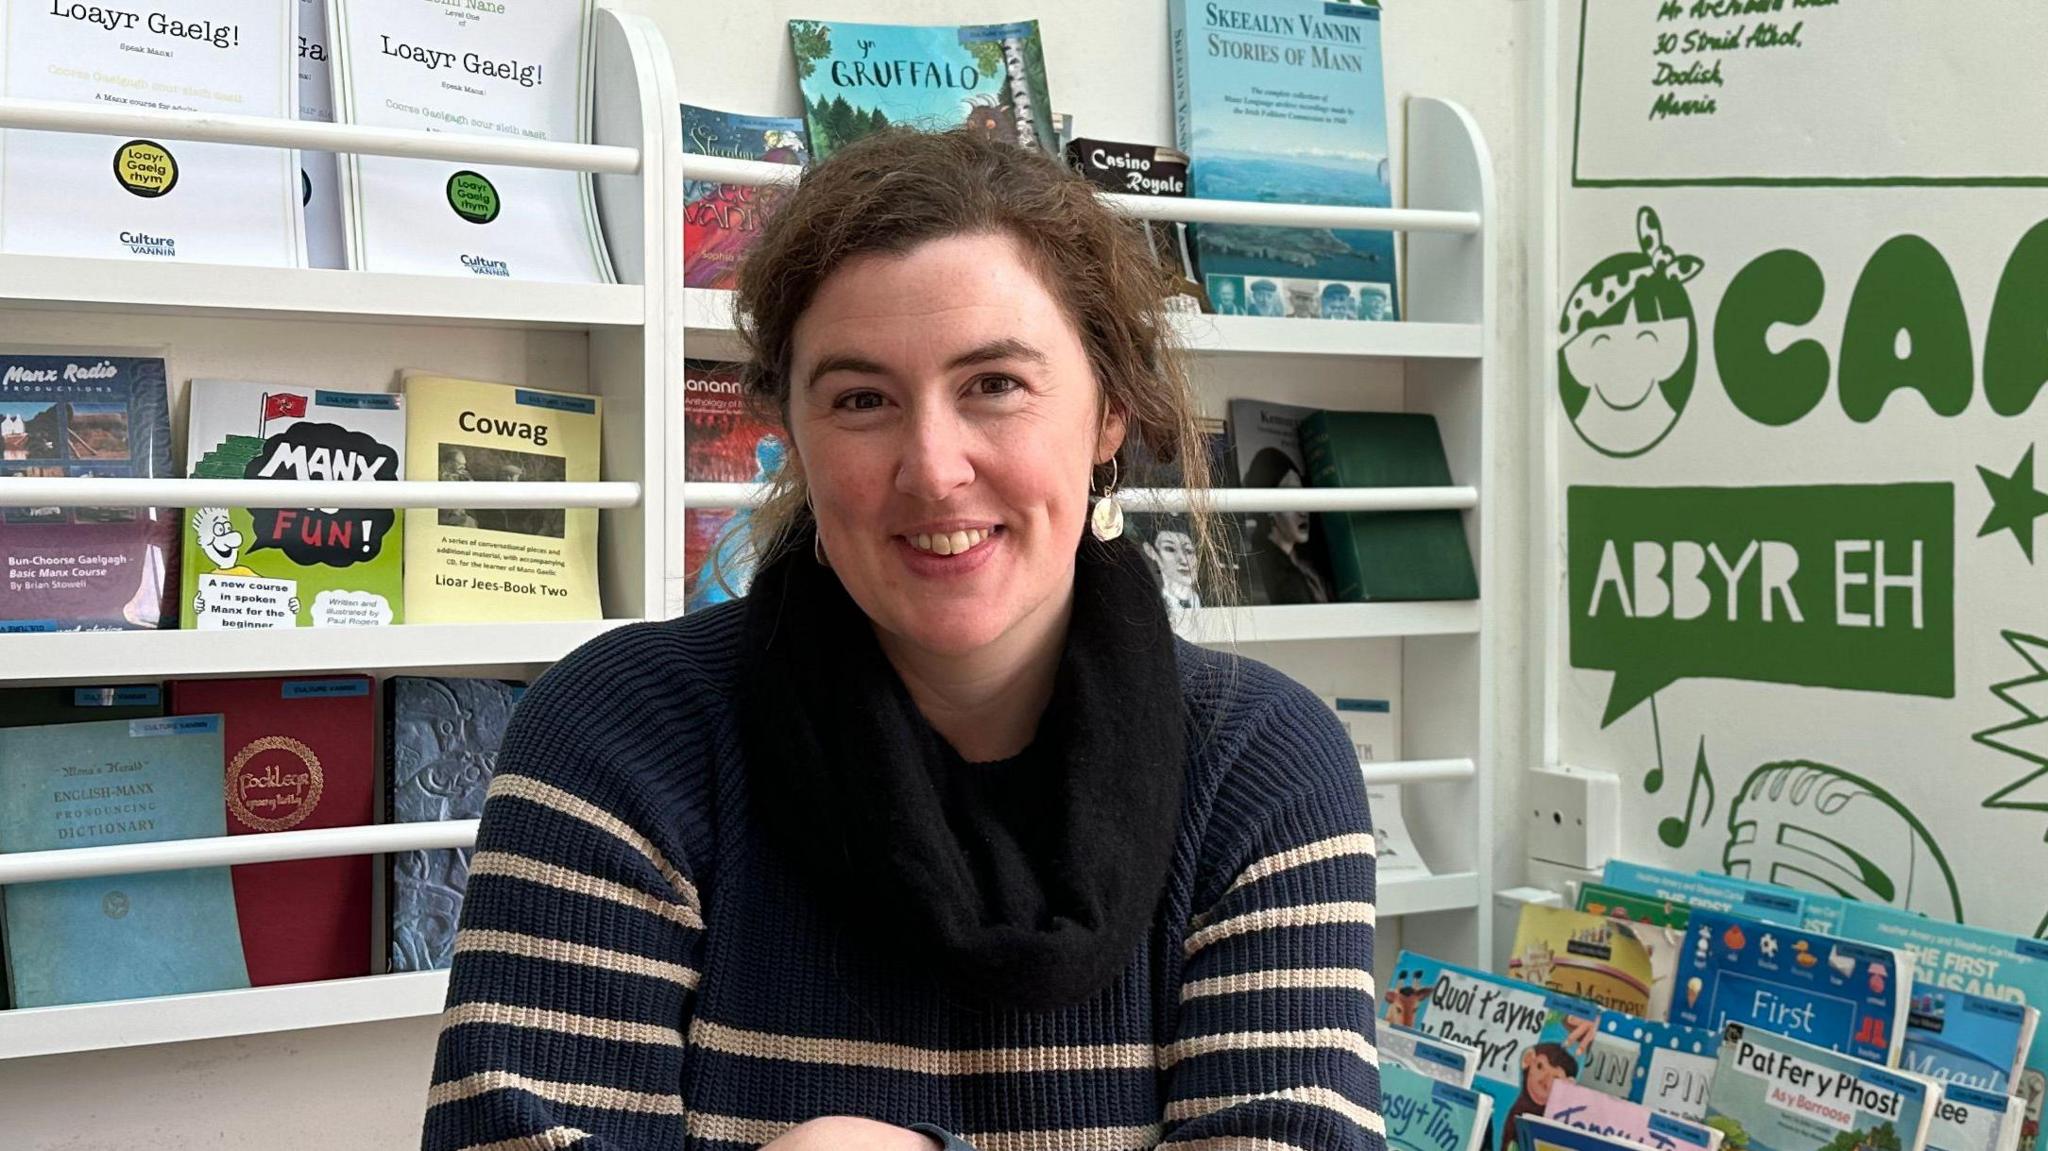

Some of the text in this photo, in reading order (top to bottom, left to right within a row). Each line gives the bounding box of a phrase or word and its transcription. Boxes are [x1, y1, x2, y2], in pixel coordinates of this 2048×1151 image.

[50, 0, 239, 49] Loayr Gaelg!
[1653, 33, 1678, 55] 30
[380, 35, 543, 87] Loayr Gaelg!
[831, 60, 979, 90] GRUFFALO
[128, 149, 164, 163] Loayr
[1091, 149, 1151, 171] Casino
[126, 160, 166, 176] Gaelg
[129, 172, 163, 184] rhym
[457, 178, 487, 192] Loayr
[1126, 172, 1184, 195] Royale
[457, 189, 490, 205] Gaelg
[461, 199, 489, 212] rhym
[120, 231, 175, 246] Culture
[130, 245, 176, 257] VANNIN
[460, 254, 507, 269] Culture
[2, 360, 118, 386] Manx Radio
[3, 385, 112, 393] PRODUCTIONS
[458, 411, 549, 447] Cowag
[258, 442, 388, 481] MANX
[8, 554, 127, 567] Bun-Choorse Gaelgagh
[9, 567, 108, 579] Basic Manx Course
[10, 579, 87, 591] By Brian Stowell
[208, 579, 289, 592] A new course
[435, 574, 568, 597] Lioar Jees-Book Two
[1588, 539, 1924, 629] ABBYR EH
[235, 594, 276, 604] spoken
[361, 599, 377, 607] and
[211, 605, 285, 618] Manx for the
[222, 619, 274, 629] beginner
[327, 617, 379, 626] Paul Rogers
[54, 783, 155, 803] ENGLISH-MANX
[56, 802, 156, 820] PRONOUNCING
[58, 819, 156, 840] DICTIONARY
[1943, 951, 1999, 979] FIRST
[1432, 975, 1479, 1016] Quoi
[1751, 989, 1816, 1033] First
[1737, 1043, 1775, 1075] Pat
[1777, 1055, 1814, 1088] Fer
[1818, 1074, 1833, 1098] y
[1835, 1072, 1900, 1117] Phost
[1771, 1087, 1787, 1102] As
[1798, 1095, 1851, 1125] Barroose
